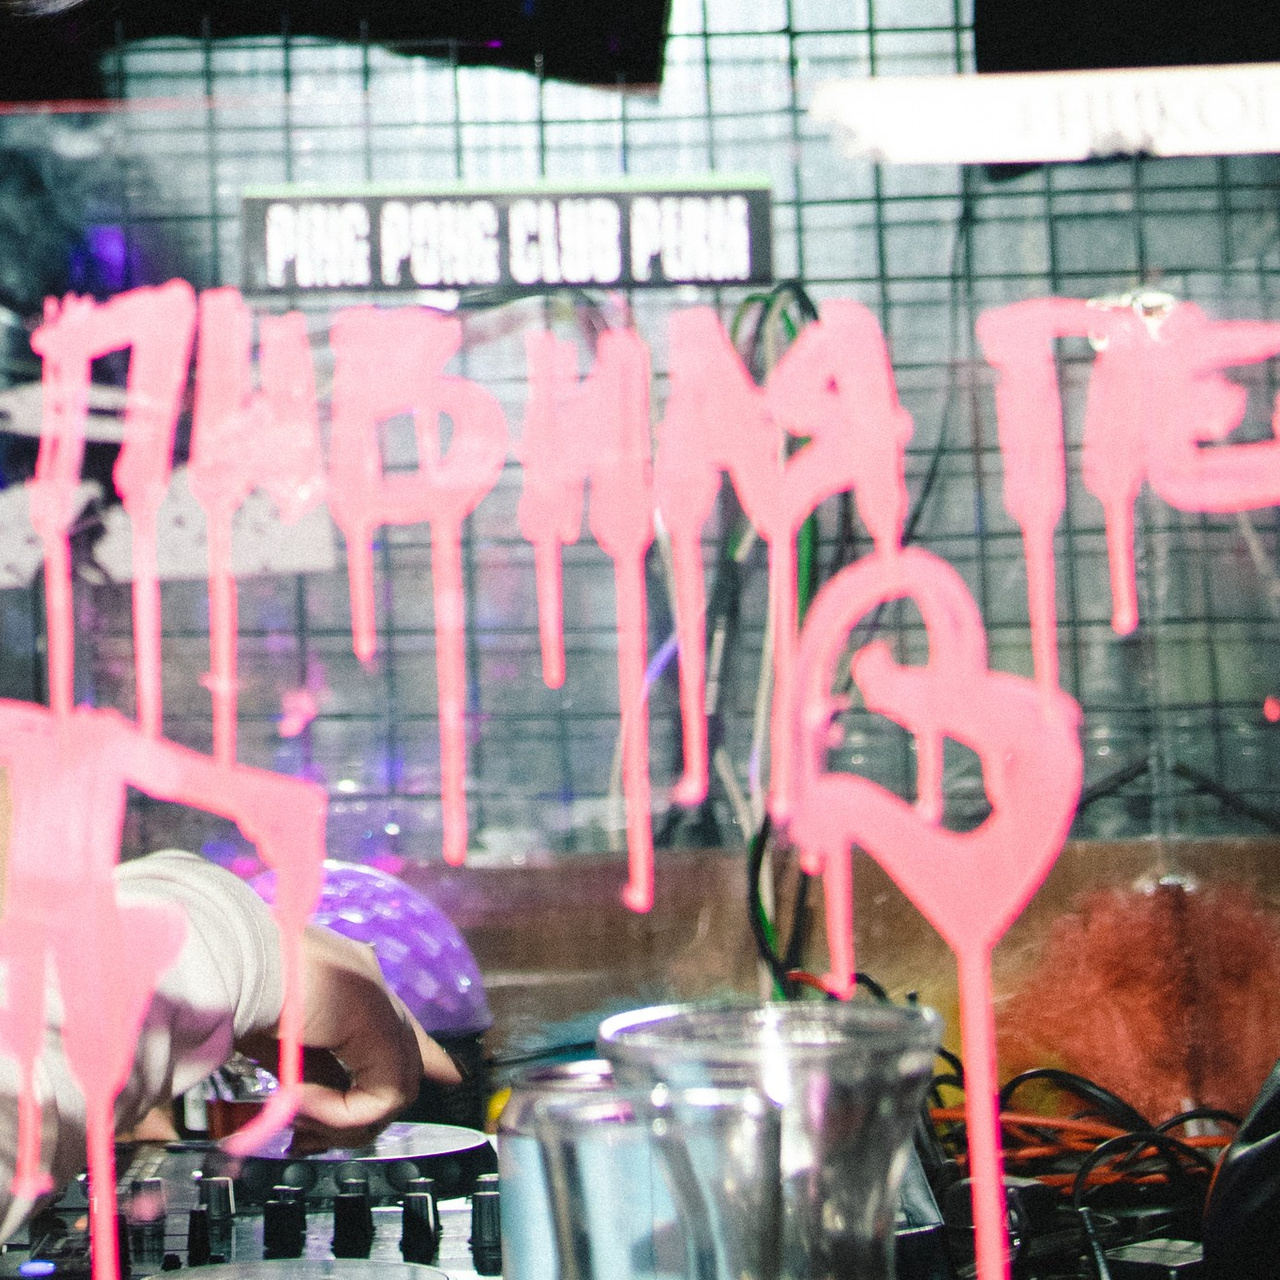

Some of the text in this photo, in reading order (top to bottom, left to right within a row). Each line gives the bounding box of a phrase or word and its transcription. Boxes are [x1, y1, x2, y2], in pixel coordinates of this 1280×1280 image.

[266, 201, 371, 288] PING
[380, 200, 500, 287] PONG
[508, 198, 621, 284] CLUB
